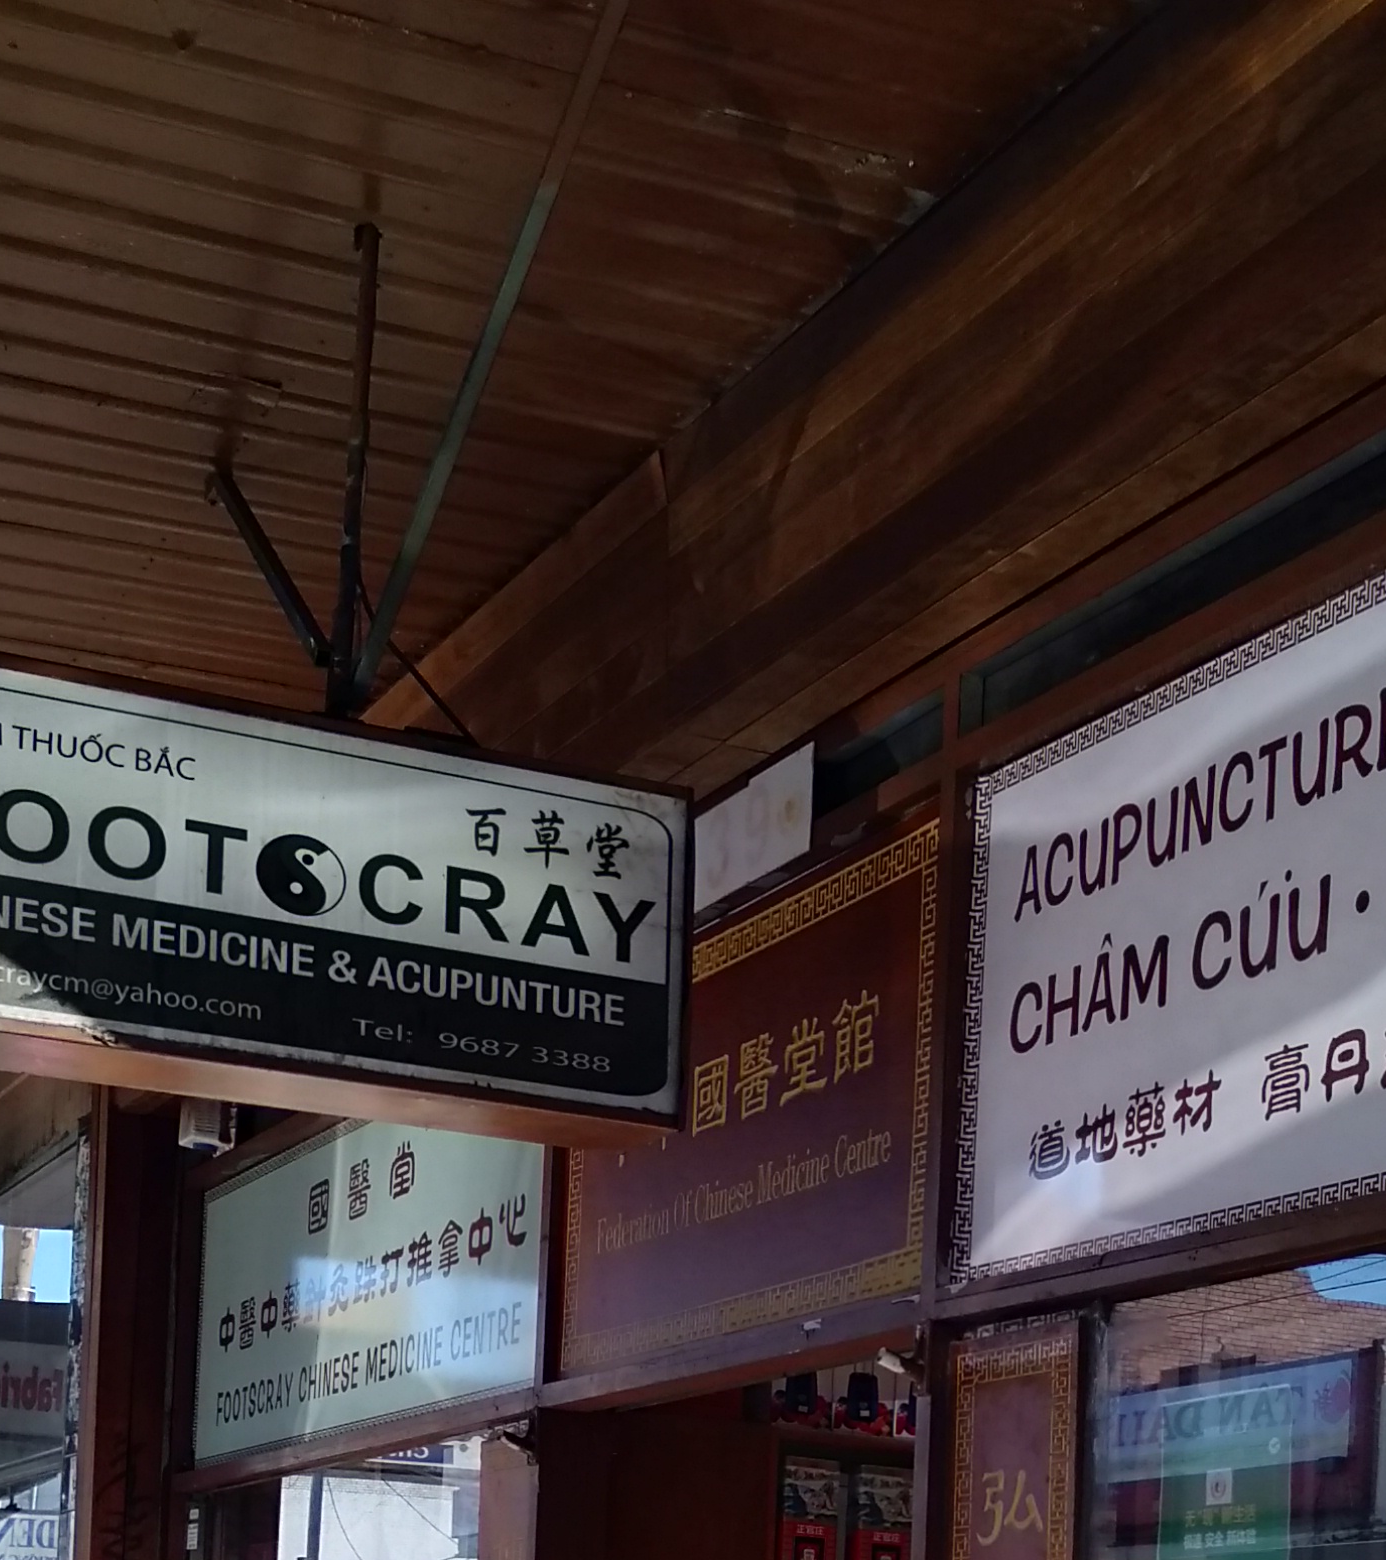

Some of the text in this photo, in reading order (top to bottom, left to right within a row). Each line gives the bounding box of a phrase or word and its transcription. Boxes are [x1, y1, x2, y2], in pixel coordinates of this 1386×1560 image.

[12, 724, 126, 769] THUỐC
[134, 746, 197, 781] BẮC
[465, 808, 630, 880] 百草堂
[113, 912, 315, 978] MEDICINE
[327, 949, 358, 985] &
[367, 956, 626, 1027] ACUPUNTURE
[1009, 934, 1170, 1055] CHÂM
[352, 1017, 612, 1073] Tel: 9687 3388
[692, 989, 881, 1138] 國醫堂館
[1028, 1069, 1223, 1181] 道地藥材
[307, 1141, 416, 1235] 國醫堂
[596, 1127, 893, 1255] Federation Of Chinese Medicine Centre
[215, 1301, 522, 1427] FOOTSCRAY CHINESE MEDICINE CENTRE
